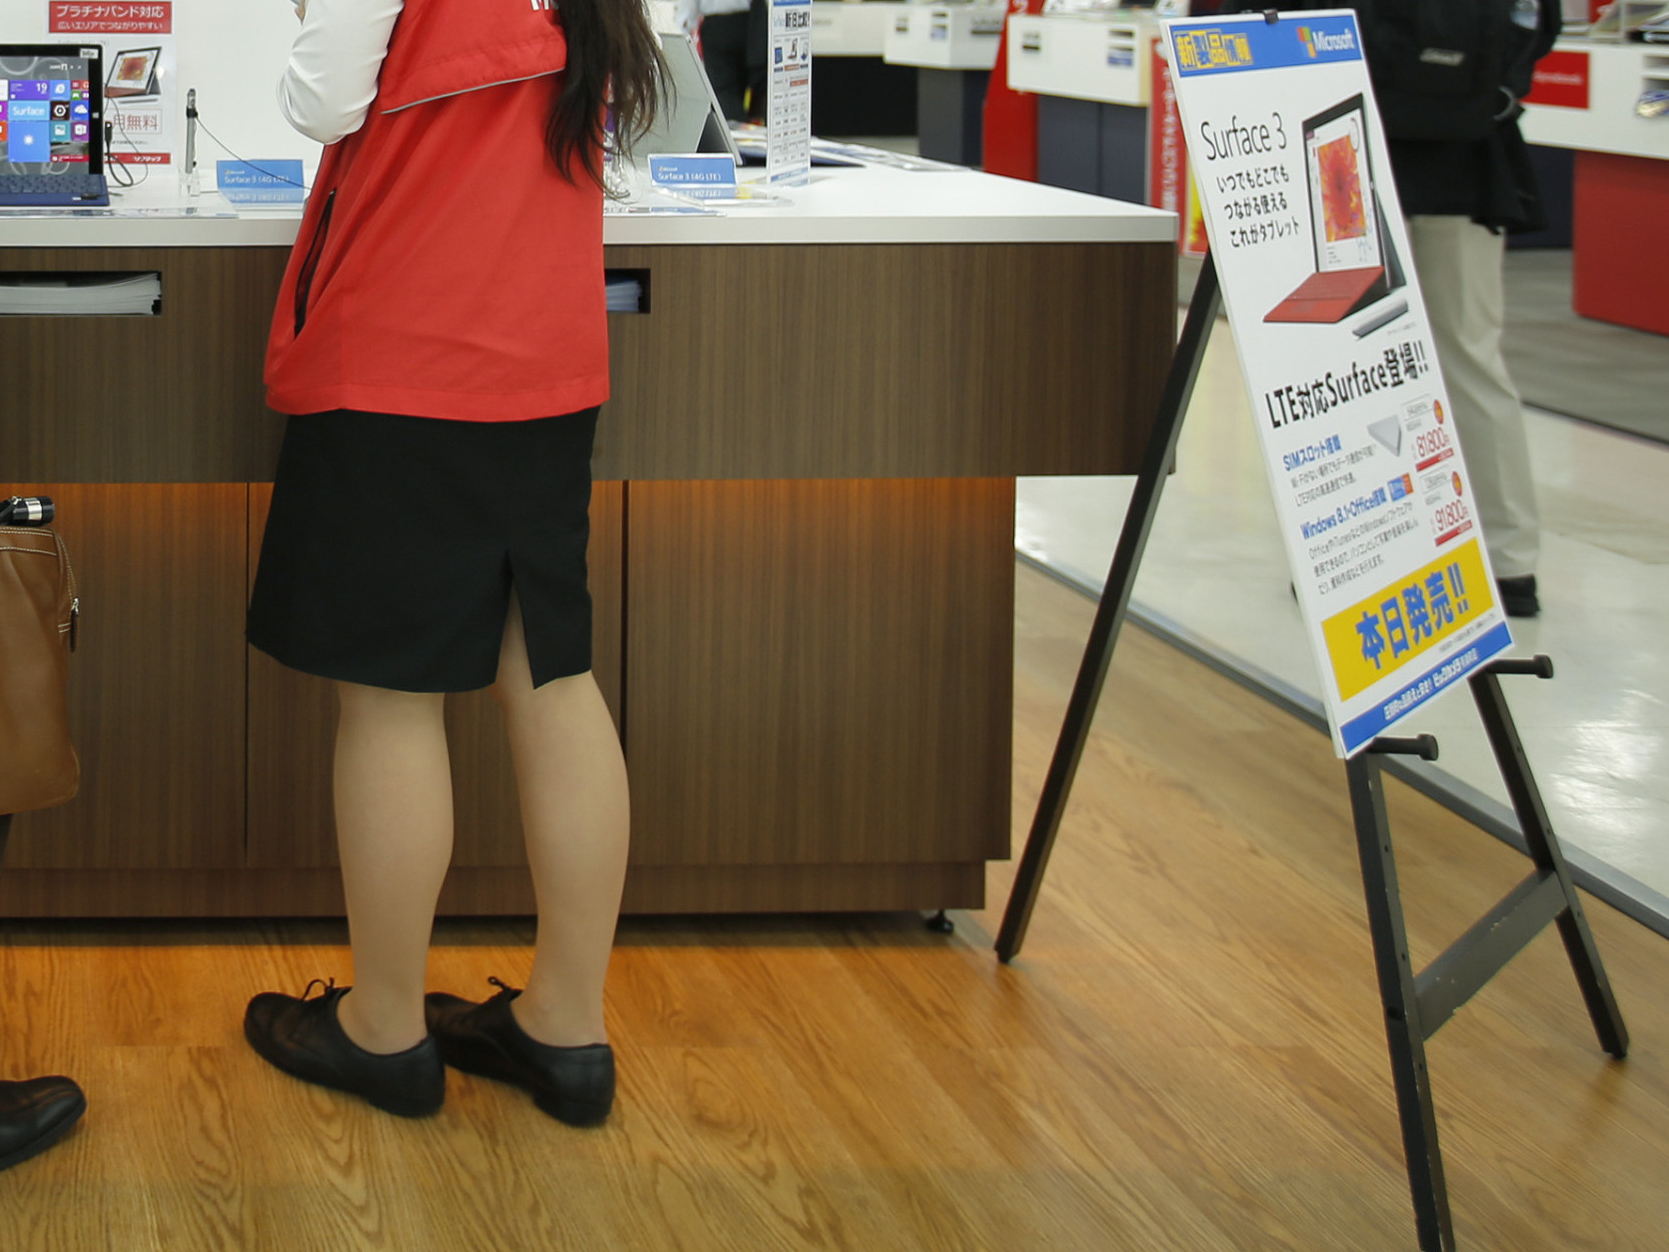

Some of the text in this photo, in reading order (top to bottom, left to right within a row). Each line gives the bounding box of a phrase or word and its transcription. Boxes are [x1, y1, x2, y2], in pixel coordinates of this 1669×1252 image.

[57, 5, 164, 18] プラチナバンド対応
[57, 21, 163, 30] 広いエリアでつながりやすい
[1312, 29, 1356, 53] Microsoft
[13, 106, 45, 116] Surface
[1200, 112, 1288, 160] Surface 3
[224, 175, 250, 184] Surface
[705, 172, 721, 181] LTE)
[1216, 164, 1290, 194] いつでもどこでも
[1224, 191, 1287, 220] つながる使える
[1229, 215, 1300, 248] これがタブレット
[1266, 340, 1429, 429] LTE対応Surface登場!!
[1300, 514, 1337, 540] Windows
[1356, 562, 1470, 670] 本日発売!!
